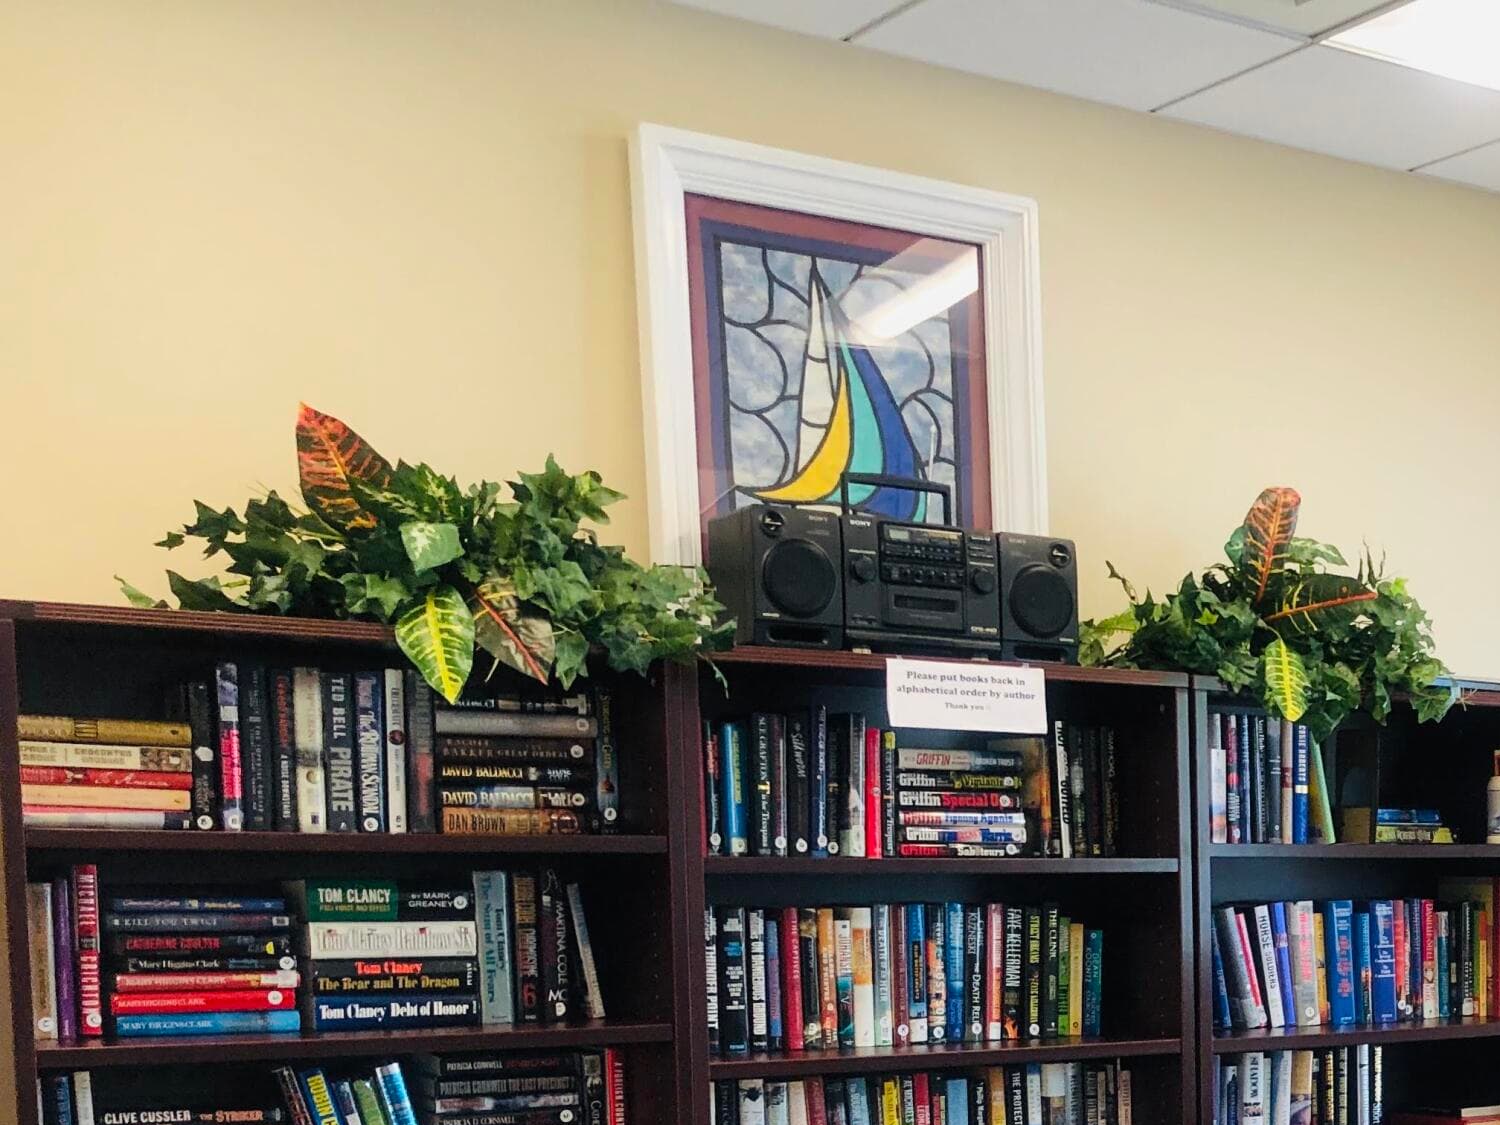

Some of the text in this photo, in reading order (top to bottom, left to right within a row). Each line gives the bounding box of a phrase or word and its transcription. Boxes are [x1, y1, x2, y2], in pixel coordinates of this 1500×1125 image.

[850, 519, 871, 527] SONY
[906, 671, 937, 681] Please
[960, 675, 988, 683] books
[991, 677, 1013, 685] back
[897, 684, 1035, 700] alphabetical order by author
[331, 678, 346, 739] TED BELL
[760, 736, 769, 781] GRAFTON
[916, 753, 951, 765] GRIFFIN
[330, 747, 353, 812] PIRATE
[442, 767, 522, 779] DAVID BALDACCI
[900, 773, 935, 786] Griffin
[443, 792, 533, 805] DAVID BALDACCI
[757, 781, 770, 795] T
[900, 792, 941, 806] Griffin
[942, 793, 988, 808] Special
[448, 814, 505, 831] DAN BROWN
[317, 888, 391, 903] TOM CLANCY
[408, 900, 453, 908] GREANEY
[422, 892, 450, 900] MARK
[495, 908, 504, 930] Tom
[481, 877, 495, 1003] The Sum of All Fears
[556, 901, 568, 984] MARTINA COLE
[968, 912, 976, 955] KUZNESKI
[1049, 909, 1057, 960] THE CLINIC
[1258, 915, 1271, 949] HORSE
[79, 874, 100, 1014] MICHAEL CRICHTON
[878, 930, 887, 960] DEATH
[1006, 908, 1022, 987] FAYE KELLERMAN
[355, 962, 423, 975] Tom Clancy
[751, 955, 765, 1000] DANGEROUS
[318, 976, 460, 991] The Bear and The Dragon
[879, 980, 888, 1002] HEIR
[972, 974, 981, 1003] DEATH
[319, 1000, 468, 1022] Tom Clancy Debt of Honor
[707, 995, 719, 1029] POINT
[752, 1002, 767, 1035] GROUND
[447, 1060, 503, 1071] PATRICIA CORNWELL
[1012, 1072, 1021, 1087] THE
[1249, 1056, 1260, 1098] SHADOW
[307, 1075, 334, 1116] ROBIN
[904, 1089, 913, 1123] MICHAELS
[104, 1109, 191, 1125] CLIVE CUSSLER
